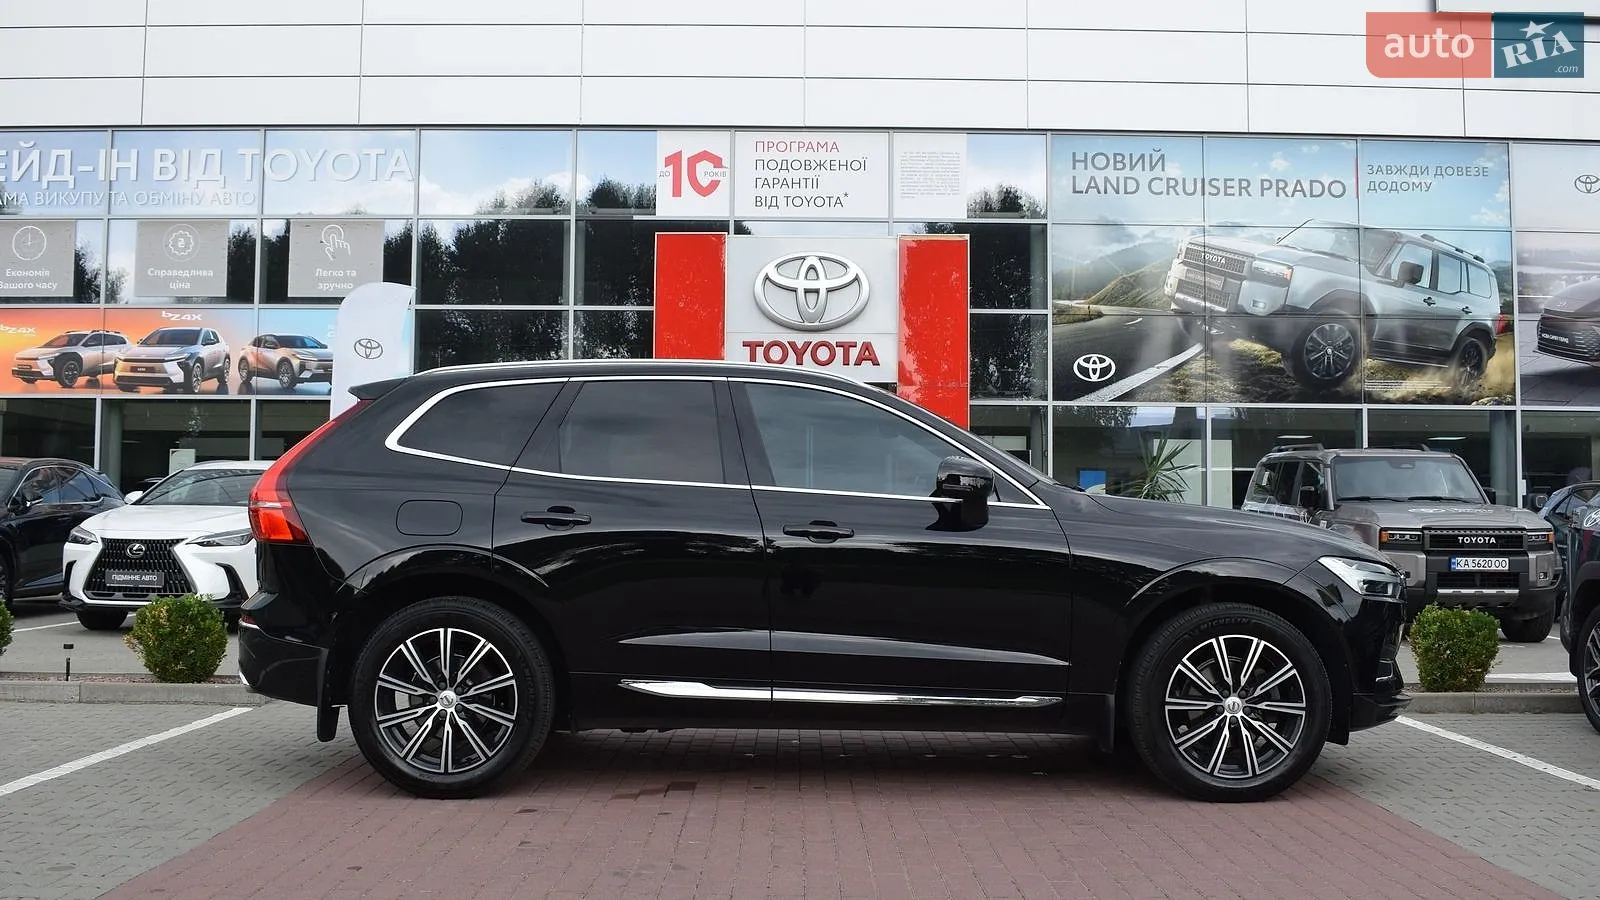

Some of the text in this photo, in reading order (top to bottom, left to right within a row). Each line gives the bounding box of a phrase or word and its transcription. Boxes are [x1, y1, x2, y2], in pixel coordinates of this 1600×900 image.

[754, 140, 840, 153] ПРОГРАМА
[754, 156, 868, 173] ПОДОВЖЕНОЇ
[1071, 147, 1166, 173] НОВИЙ
[153, 148, 226, 190] ВІД
[238, 148, 415, 183] TOYOTA
[658, 149, 727, 198] ДО 10 РОКІВ
[1366, 163, 1490, 179] ЗАВЖДИ ДОВЕЗЕ
[754, 174, 820, 189] ГАРАНТІЇ
[1071, 176, 1347, 200] LAND CRUISER PRADO
[1367, 179, 1433, 194] ДОДОМУ
[35, 191, 105, 206] ВИКУПУ
[109, 191, 129, 206] ТА
[133, 191, 203, 206] ОБМІНУ
[209, 191, 256, 206] АВТО
[754, 195, 780, 210] ВІД
[1201, 252, 1226, 264] TOYOTA
[6, 268, 50, 277] Економія
[147, 268, 214, 279] Справедлива
[315, 268, 357, 277] Легко та
[36, 281, 58, 291] часу
[169, 279, 191, 291] ціна
[317, 281, 354, 291] зручно
[742, 340, 880, 367] TOYOTA
[1457, 536, 1497, 544] TOYOTA
[1456, 559, 1470, 569] KA
[1472, 559, 1492, 569] 5620
